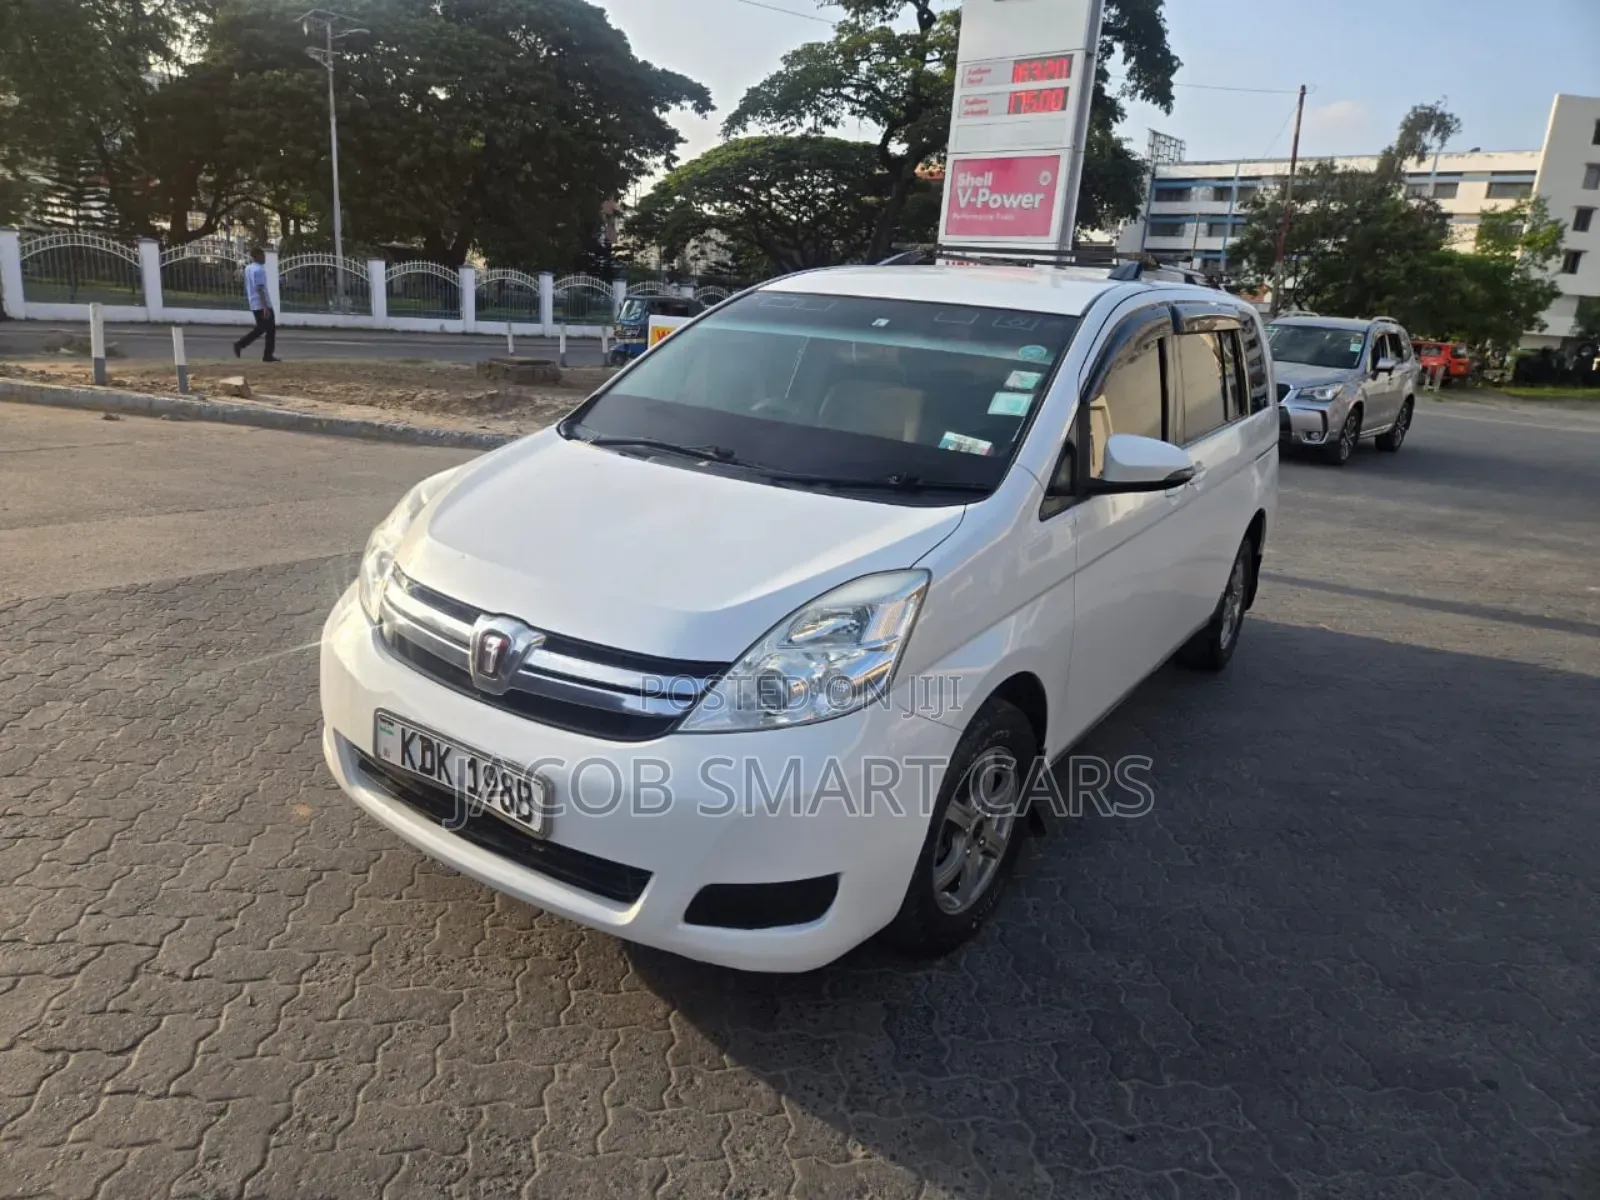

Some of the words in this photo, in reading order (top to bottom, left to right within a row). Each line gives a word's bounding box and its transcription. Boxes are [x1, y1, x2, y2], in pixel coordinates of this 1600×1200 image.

[957, 171, 993, 187] Shell
[957, 188, 1045, 210] V-Power
[401, 727, 452, 785] KDK
